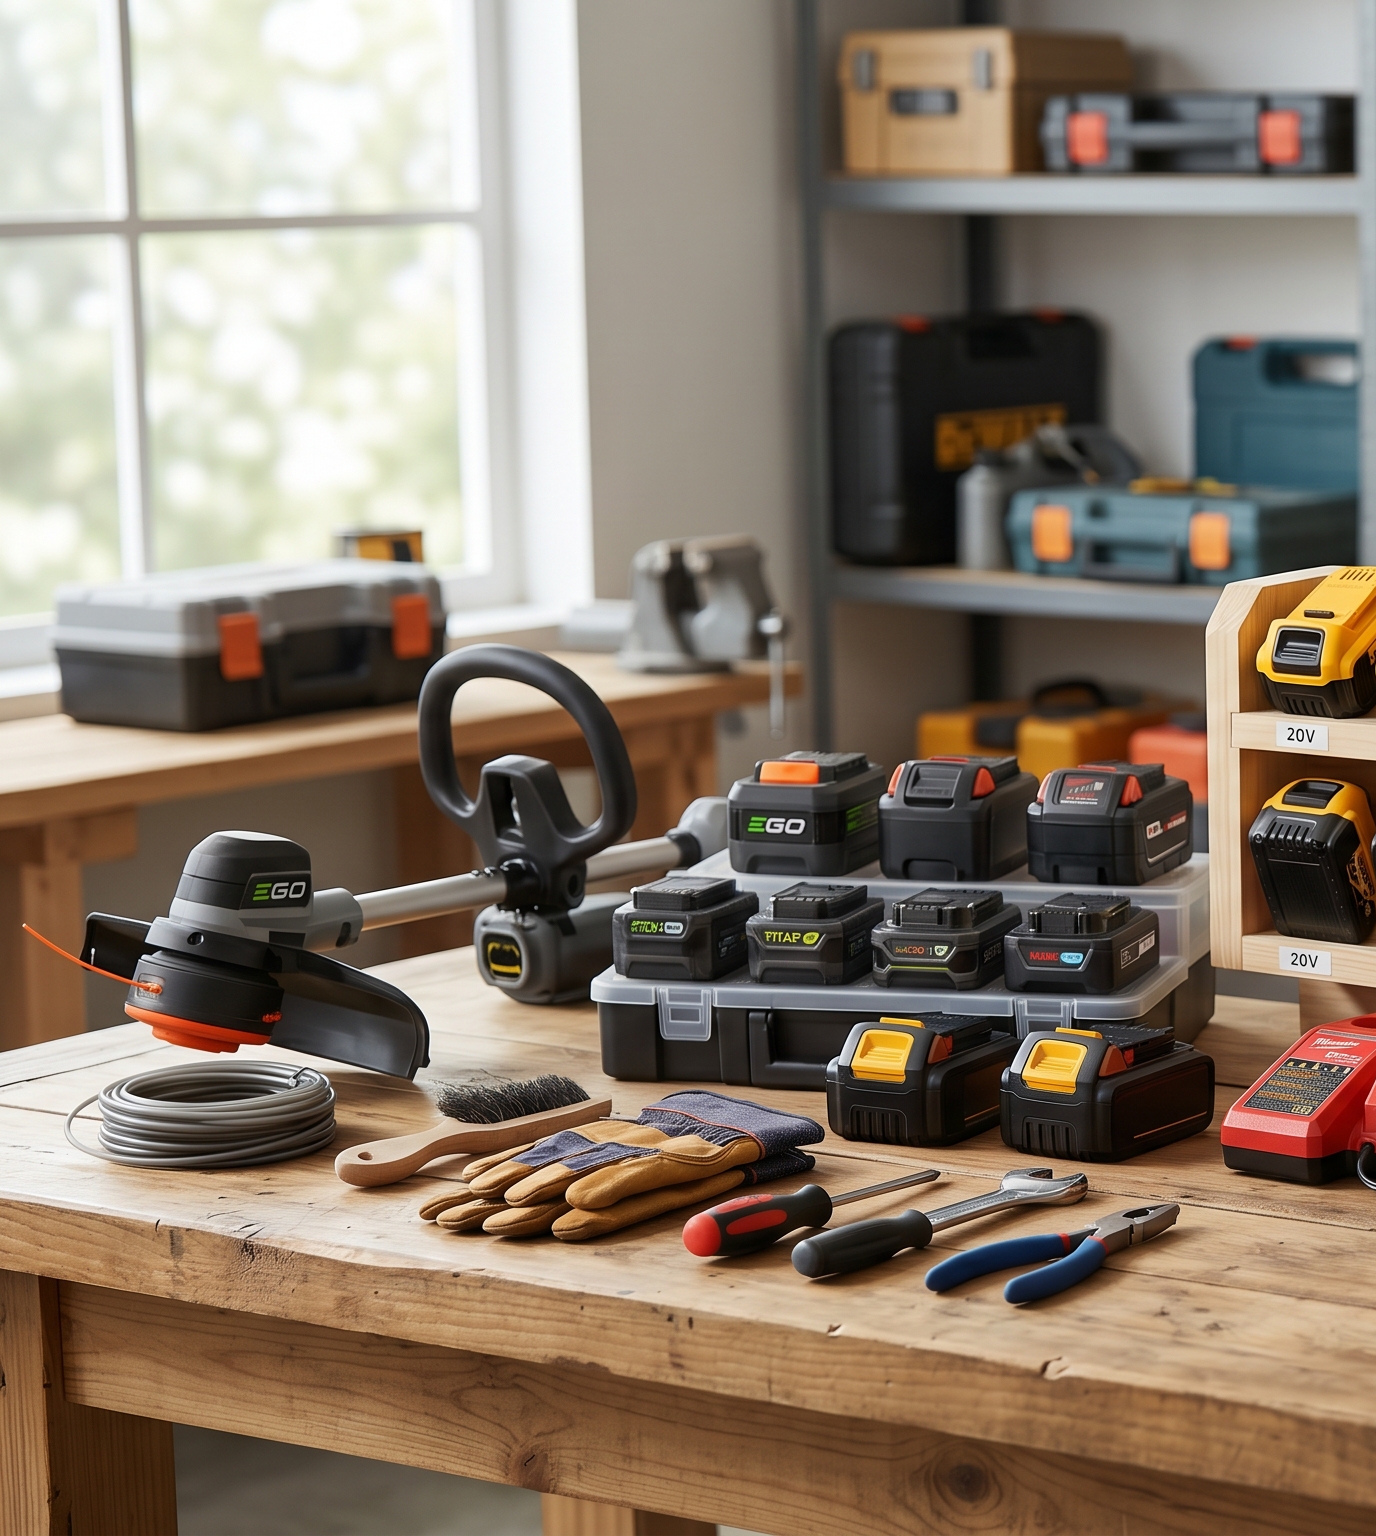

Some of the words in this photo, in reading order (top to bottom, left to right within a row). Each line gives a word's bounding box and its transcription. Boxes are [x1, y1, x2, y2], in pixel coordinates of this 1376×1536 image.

[1287, 727, 1316, 744] 20V
[747, 816, 806, 835] EGO
[252, 881, 306, 901] EGO
[1290, 952, 1319, 968] 20V
